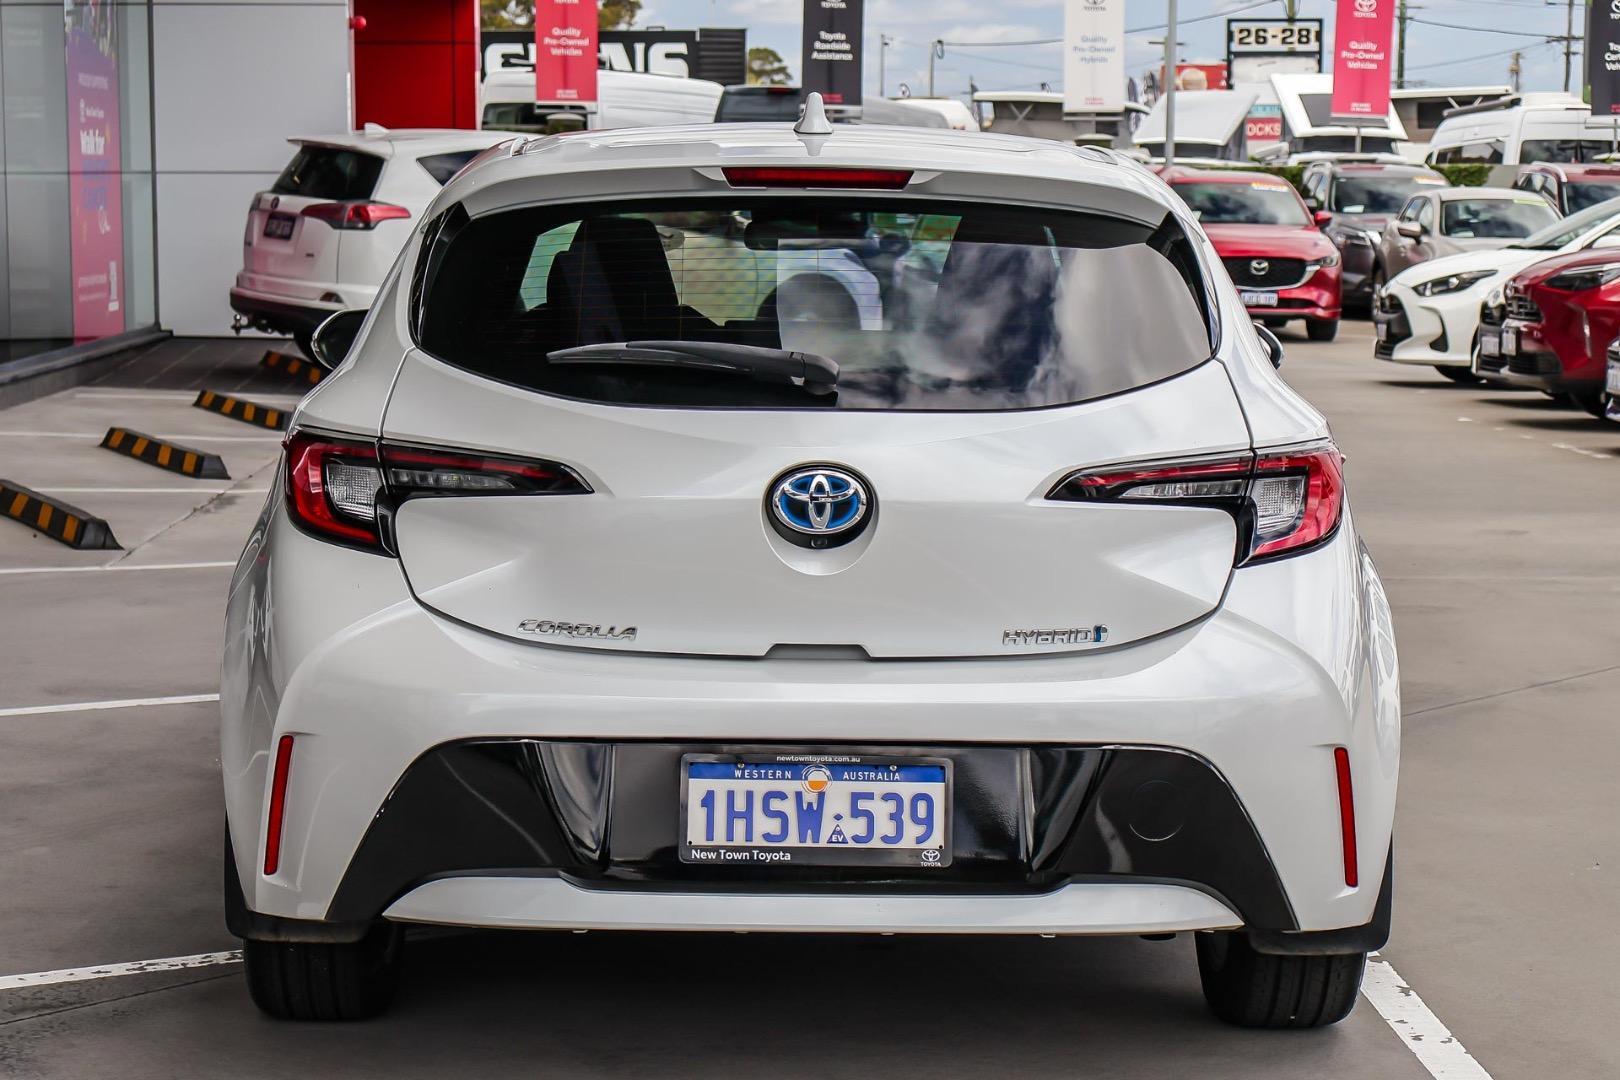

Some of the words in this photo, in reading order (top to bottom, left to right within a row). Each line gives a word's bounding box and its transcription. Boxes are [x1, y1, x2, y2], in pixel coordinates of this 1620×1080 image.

[552, 27, 581, 37] Quality
[819, 30, 846, 41] Toyota
[1238, 28, 1311, 45] 26-28
[544, 37, 590, 46] Pre-Owned
[1081, 35, 1108, 44] Quality
[813, 41, 851, 50] Roadside
[1348, 41, 1378, 51] Quality
[550, 47, 583, 56] Vehicles
[811, 51, 853, 60] Assistance
[1341, 51, 1384, 60] Pre-Owned
[1081, 57, 1108, 65] Hybrids
[1347, 60, 1378, 69] Vehicles
[517, 619, 637, 640] COROLLA
[1003, 628, 1091, 645] HYBRID
[776, 755, 861, 763] newtowntoyota.com.au
[734, 769, 792, 779] WESTERN
[843, 771, 901, 781] AUSTRALIA
[831, 834, 844, 842] EV
[691, 849, 717, 860] New
[719, 849, 750, 861] Town
[752, 850, 791, 863] Toyota
